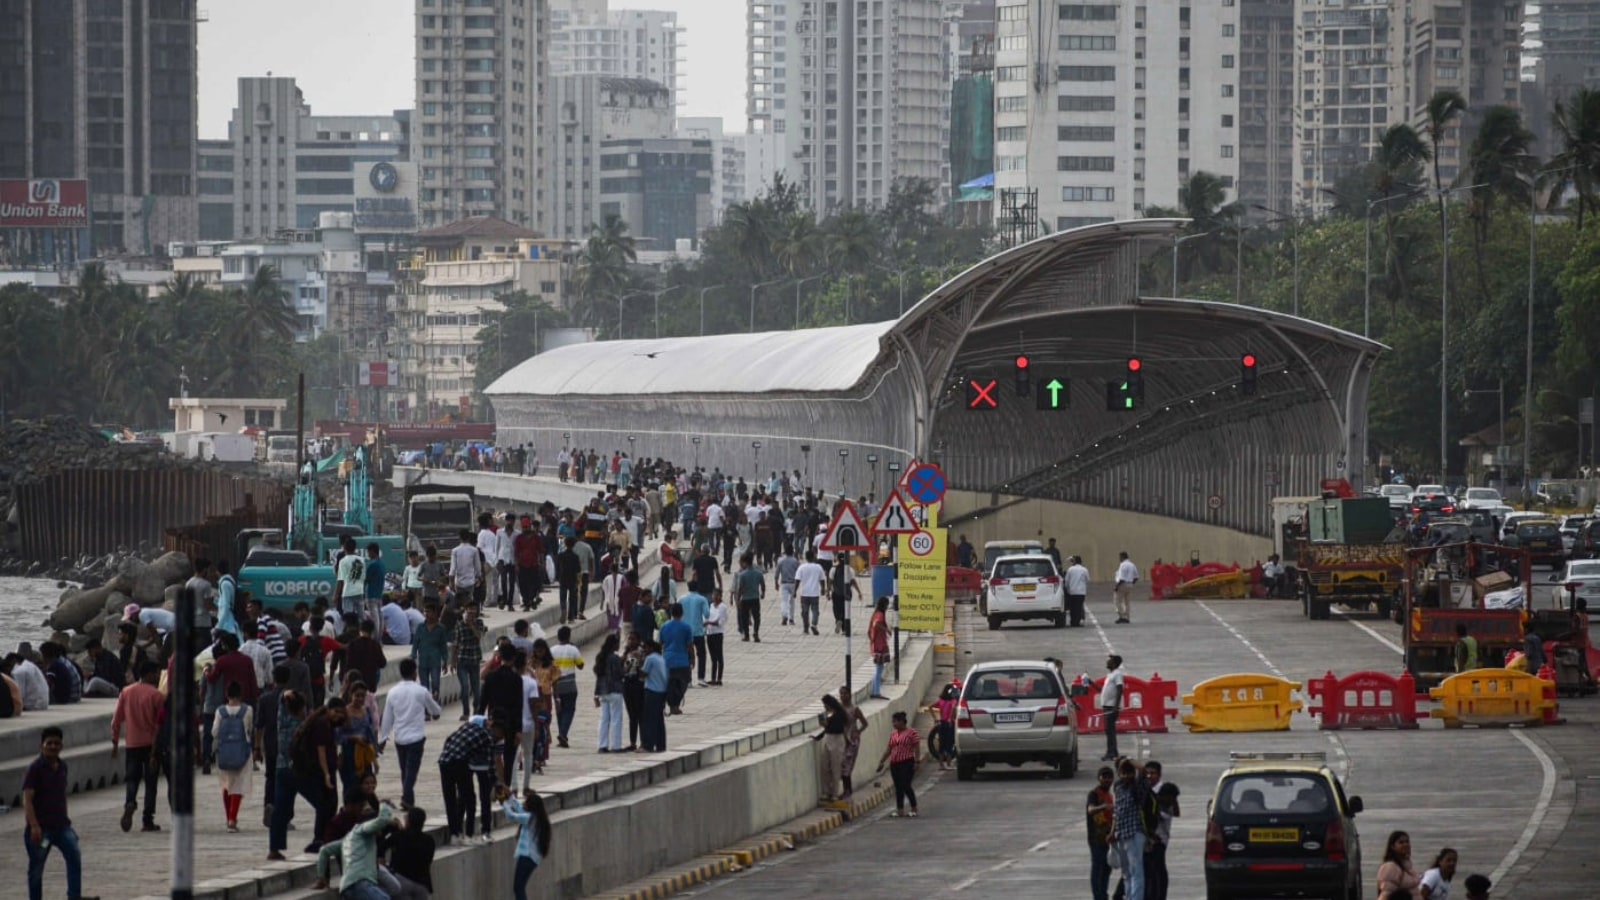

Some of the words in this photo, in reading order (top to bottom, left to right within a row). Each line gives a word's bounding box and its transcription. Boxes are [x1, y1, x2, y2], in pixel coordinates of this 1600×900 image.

[1, 203, 44, 217] Union
[47, 203, 86, 217] Bank
[914, 537, 929, 548] 60
[899, 562, 922, 570] Follow
[903, 573, 937, 581] Discipline
[265, 580, 331, 596] KOBELCO
[906, 592, 919, 600] You
[921, 592, 934, 600] Are
